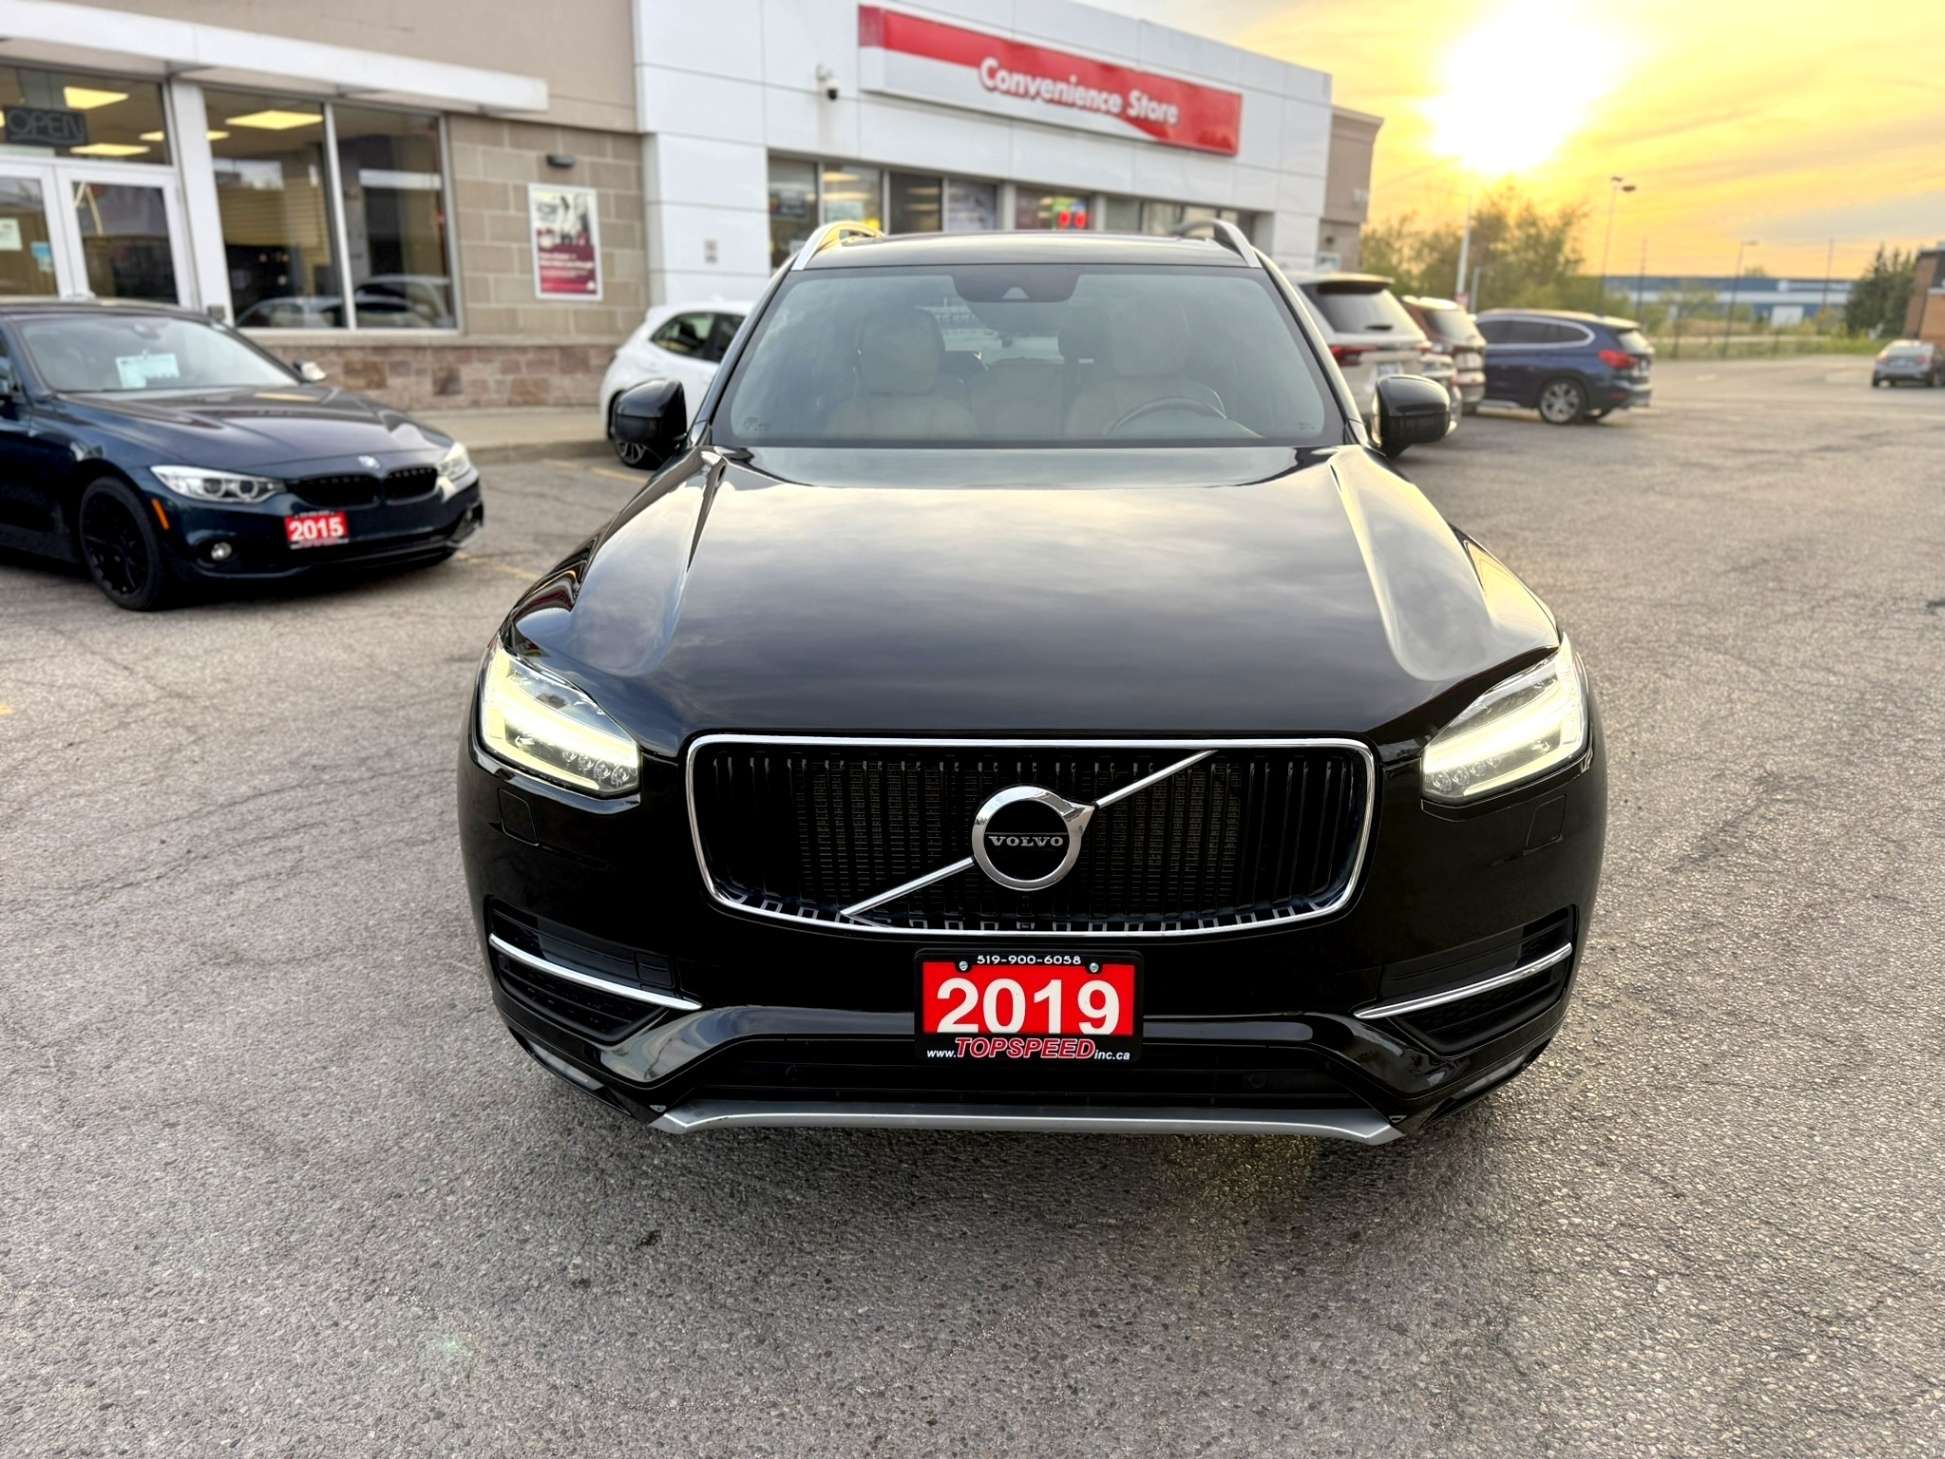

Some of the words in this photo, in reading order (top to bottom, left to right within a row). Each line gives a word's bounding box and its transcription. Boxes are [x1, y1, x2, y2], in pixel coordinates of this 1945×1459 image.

[980, 57, 1122, 113] Convenience
[1127, 89, 1180, 125] Store
[8, 109, 84, 138] OPEN
[288, 516, 345, 542] 2015
[988, 835, 1064, 847] VOLVO
[976, 954, 1082, 966] 519-900-6058
[936, 977, 1120, 1035] 2019
